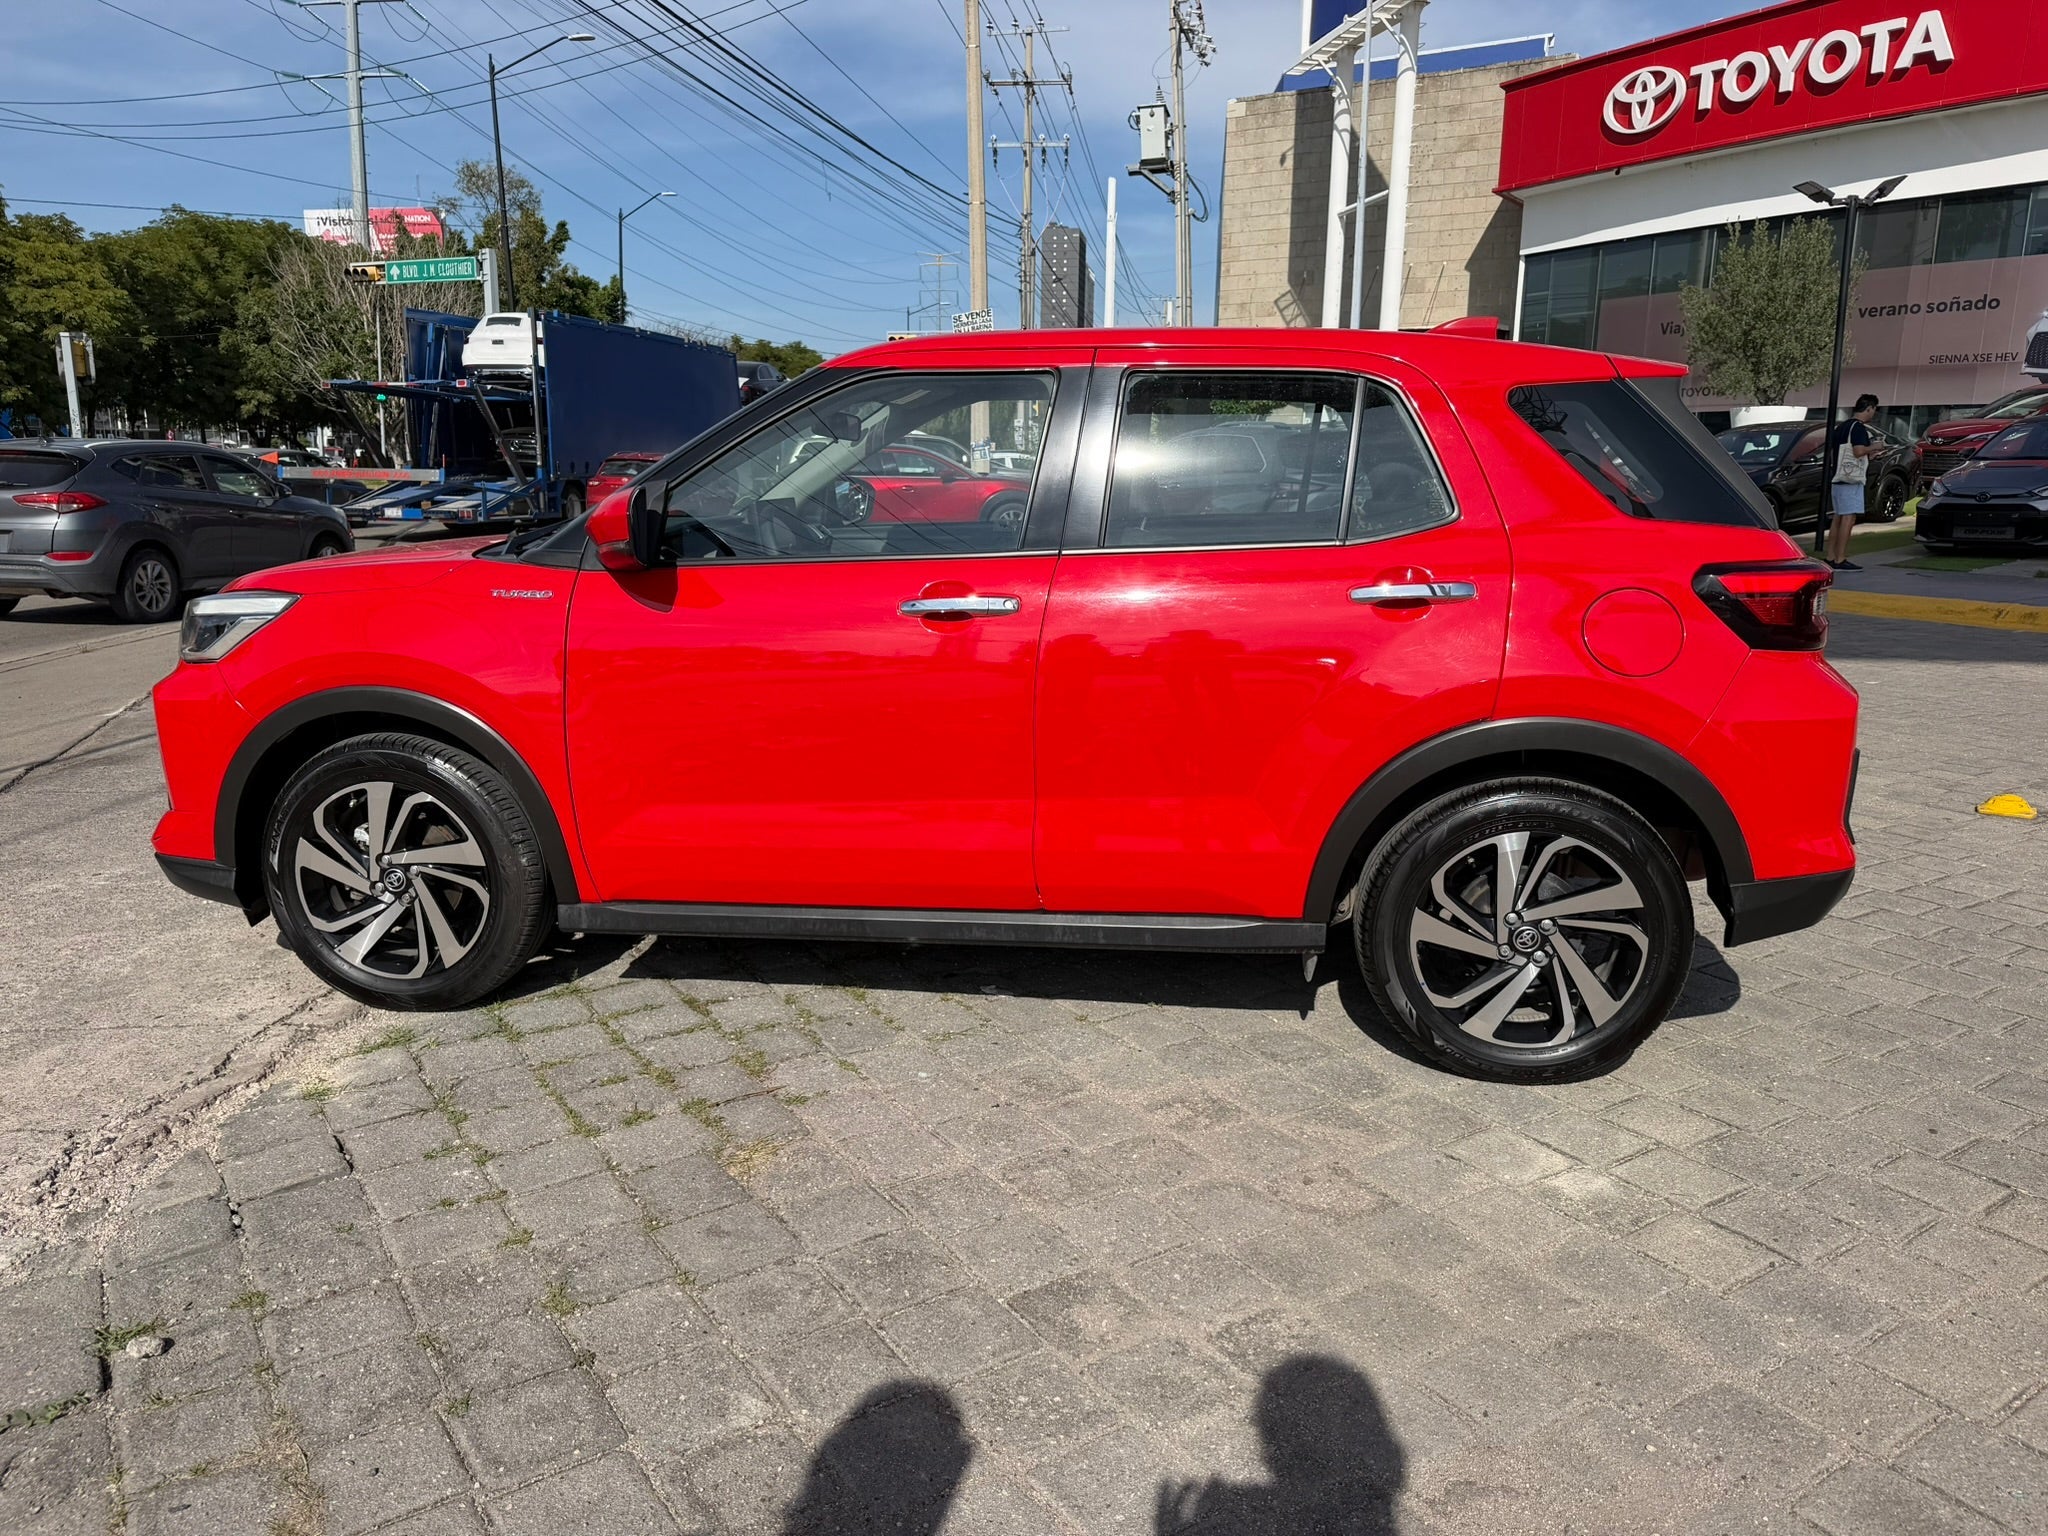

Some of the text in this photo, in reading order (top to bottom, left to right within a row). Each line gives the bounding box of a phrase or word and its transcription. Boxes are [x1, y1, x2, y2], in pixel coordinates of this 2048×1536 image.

[1689, 9, 1954, 111] TOYOTA
[438, 262, 472, 277] CLOUTHIER
[1858, 293, 2001, 318] verano soñado
[953, 309, 992, 323] SE VENDE
[1929, 351, 2019, 364] SIENNA XSE HEV
[490, 588, 554, 600] TURBO
